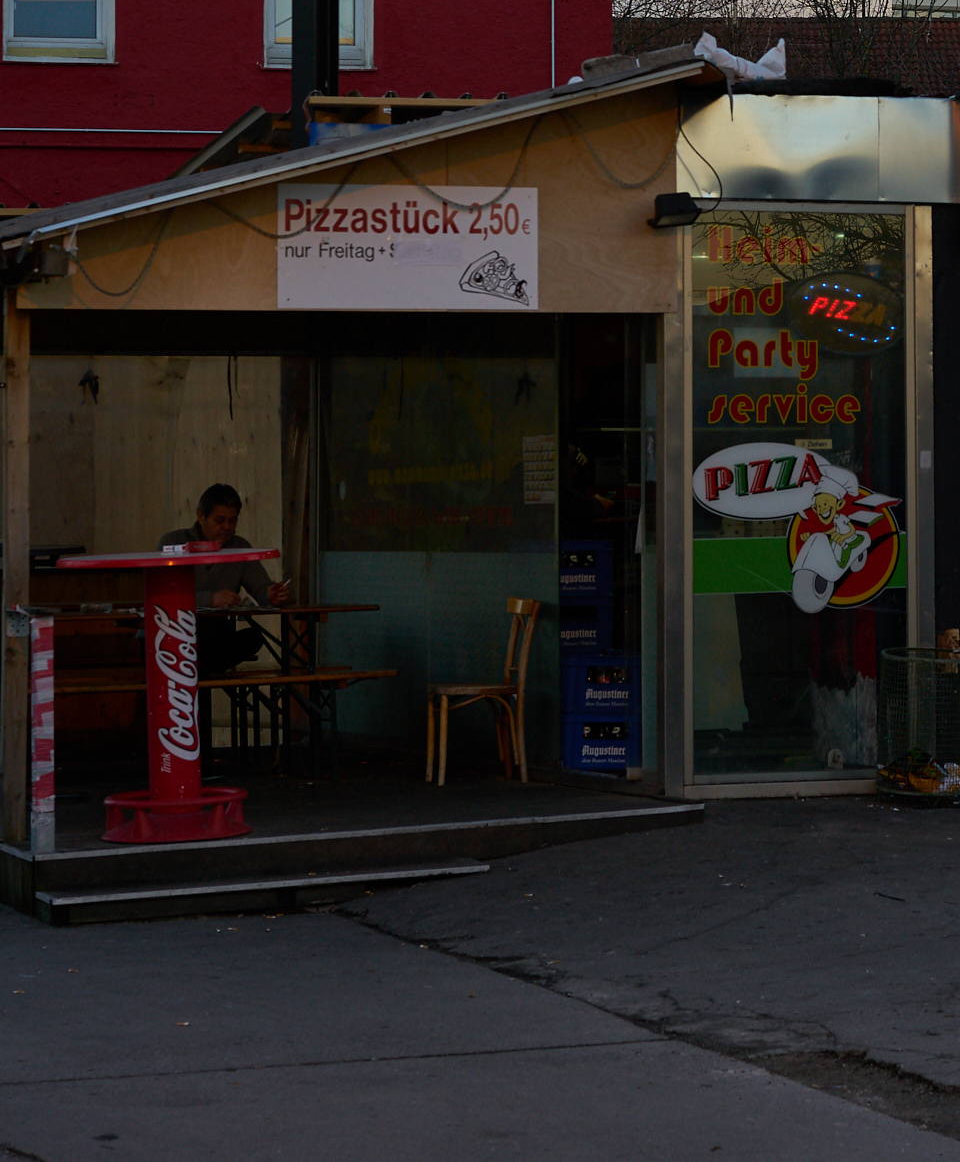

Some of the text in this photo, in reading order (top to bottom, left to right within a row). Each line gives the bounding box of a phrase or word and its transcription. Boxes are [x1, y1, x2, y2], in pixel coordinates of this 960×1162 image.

[284, 199, 460, 234] Pizzastück
[285, 244, 310, 258] nur
[318, 242, 375, 262] Freitag
[708, 225, 822, 265] Heim-
[708, 278, 784, 315] und
[807, 295, 887, 326] PIZZA
[708, 329, 818, 381] Party
[708, 383, 861, 424] service
[704, 453, 823, 501] PIZZA
[560, 573, 596, 585] ugustiner
[560, 628, 597, 640] ugustiner
[154, 604, 200, 774] Trink Coca-Cola
[585, 688, 630, 700] Augustiner
[582, 744, 626, 757] Augustiner
